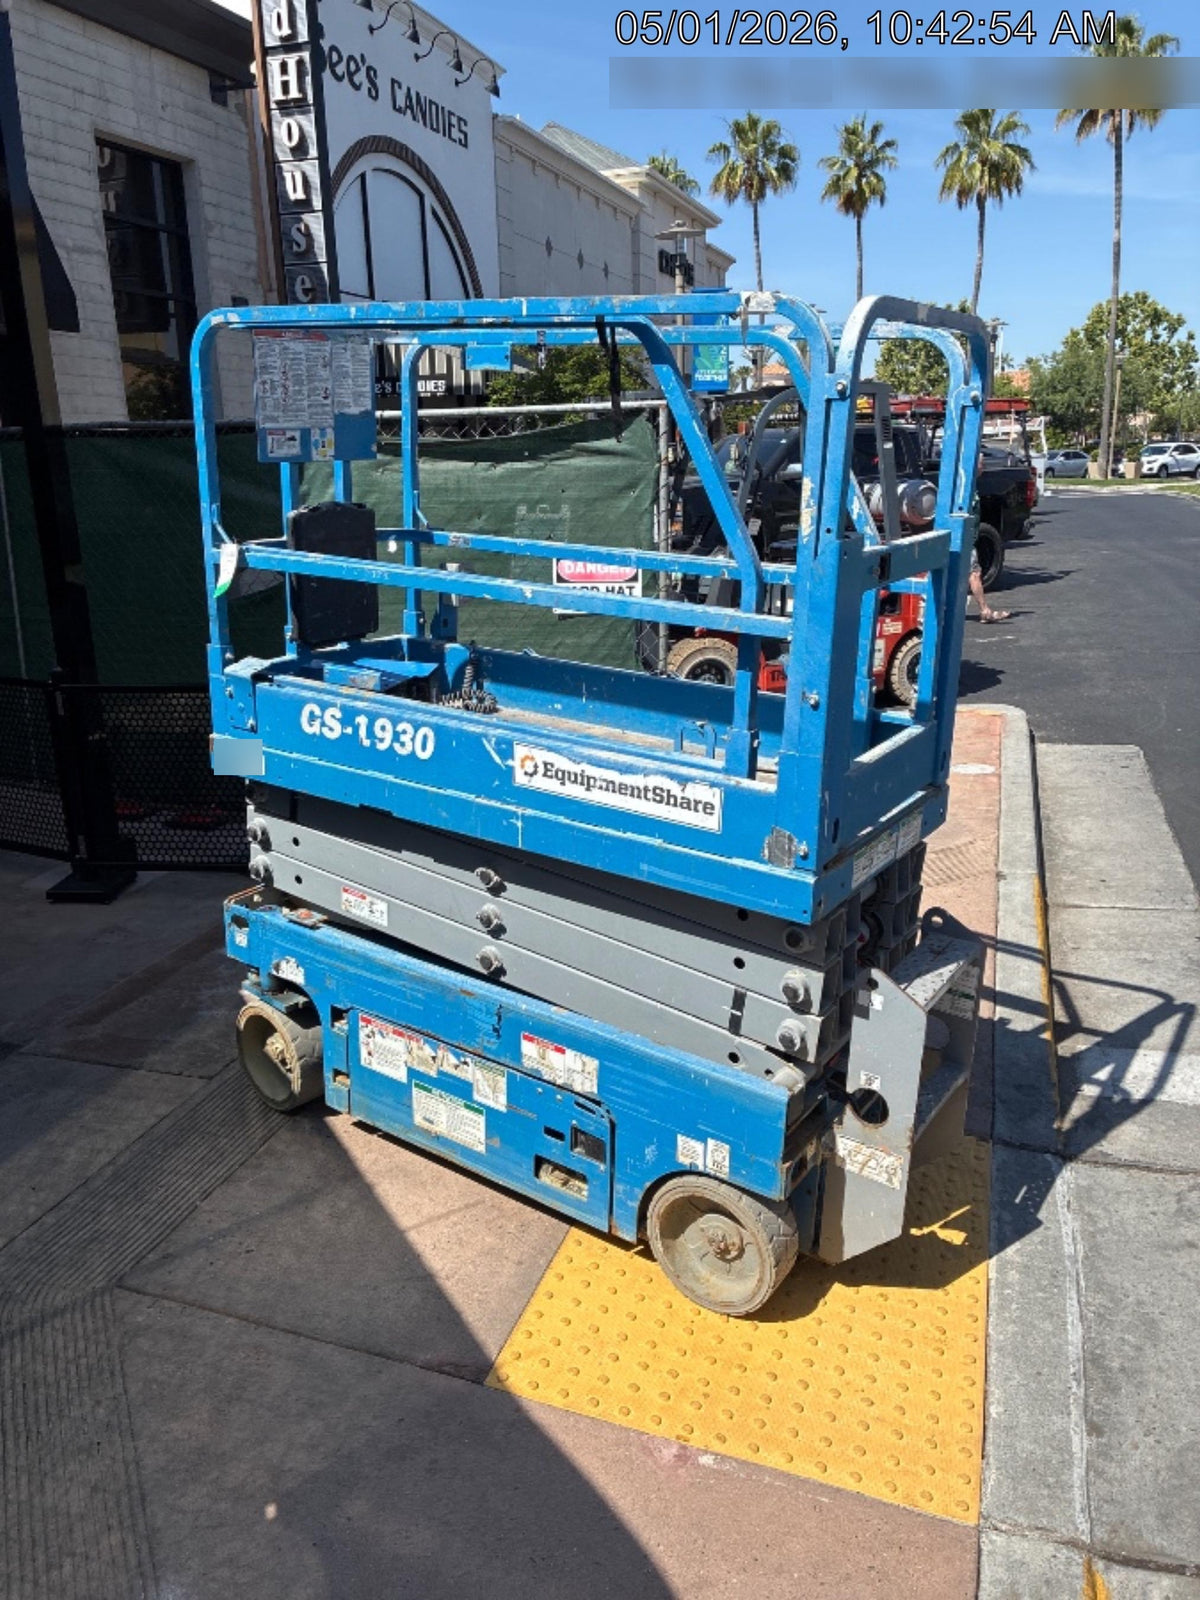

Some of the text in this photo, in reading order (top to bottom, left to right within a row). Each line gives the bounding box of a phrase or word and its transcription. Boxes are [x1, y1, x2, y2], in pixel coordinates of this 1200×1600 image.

[321, 30, 468, 149] ee's CANDIES
[300, 703, 436, 760] GS-1930
[541, 760, 716, 816] EquipmentShare
